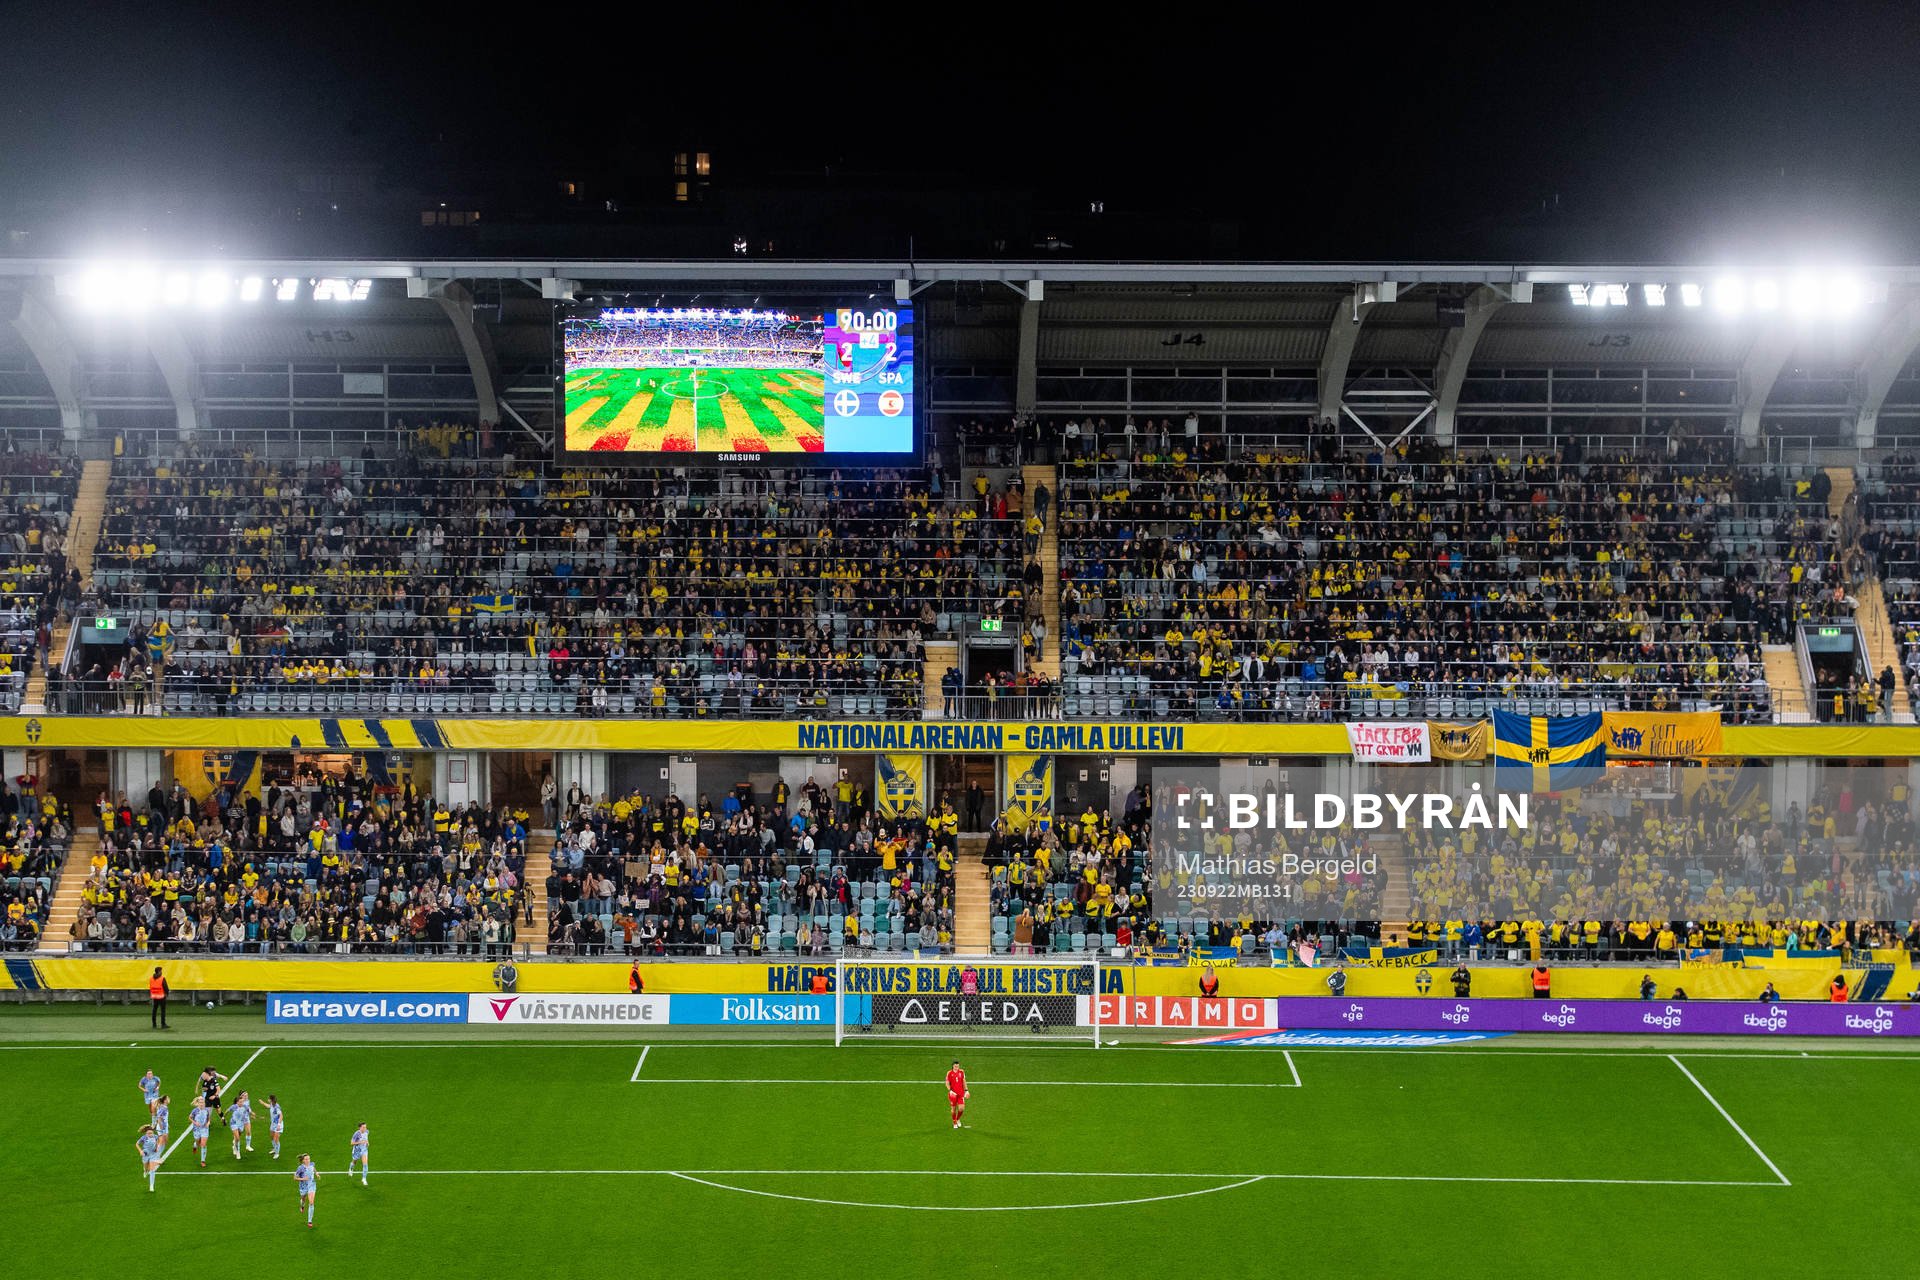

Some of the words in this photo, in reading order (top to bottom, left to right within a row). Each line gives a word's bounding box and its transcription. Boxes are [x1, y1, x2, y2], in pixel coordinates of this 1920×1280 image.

[840, 312, 897, 331] 90:00
[305, 329, 355, 342] H3
[1161, 333, 1206, 345] J4
[841, 342, 853, 361] 2
[885, 342, 897, 361] 2
[878, 373, 904, 384] SPA
[718, 453, 761, 461] SAMSUNG
[799, 724, 1002, 750] NATIONALARENAN
[1025, 725, 1099, 750] GAMLA
[1110, 726, 1183, 751] ULLEVI
[1393, 726, 1423, 744] FÖR
[1407, 743, 1422, 756] VM
[916, 965, 1007, 994] BLÅUL
[1012, 967, 1124, 994] HISTOIA
[273, 999, 460, 1018] latravel.com
[519, 1001, 652, 1020] VÄSTANHEDE
[721, 998, 820, 1021] Folksam
[938, 1001, 1044, 1021] ELEDA
[1099, 1002, 1258, 1022] CRAMO
[1845, 1014, 1892, 1033] Fabege
